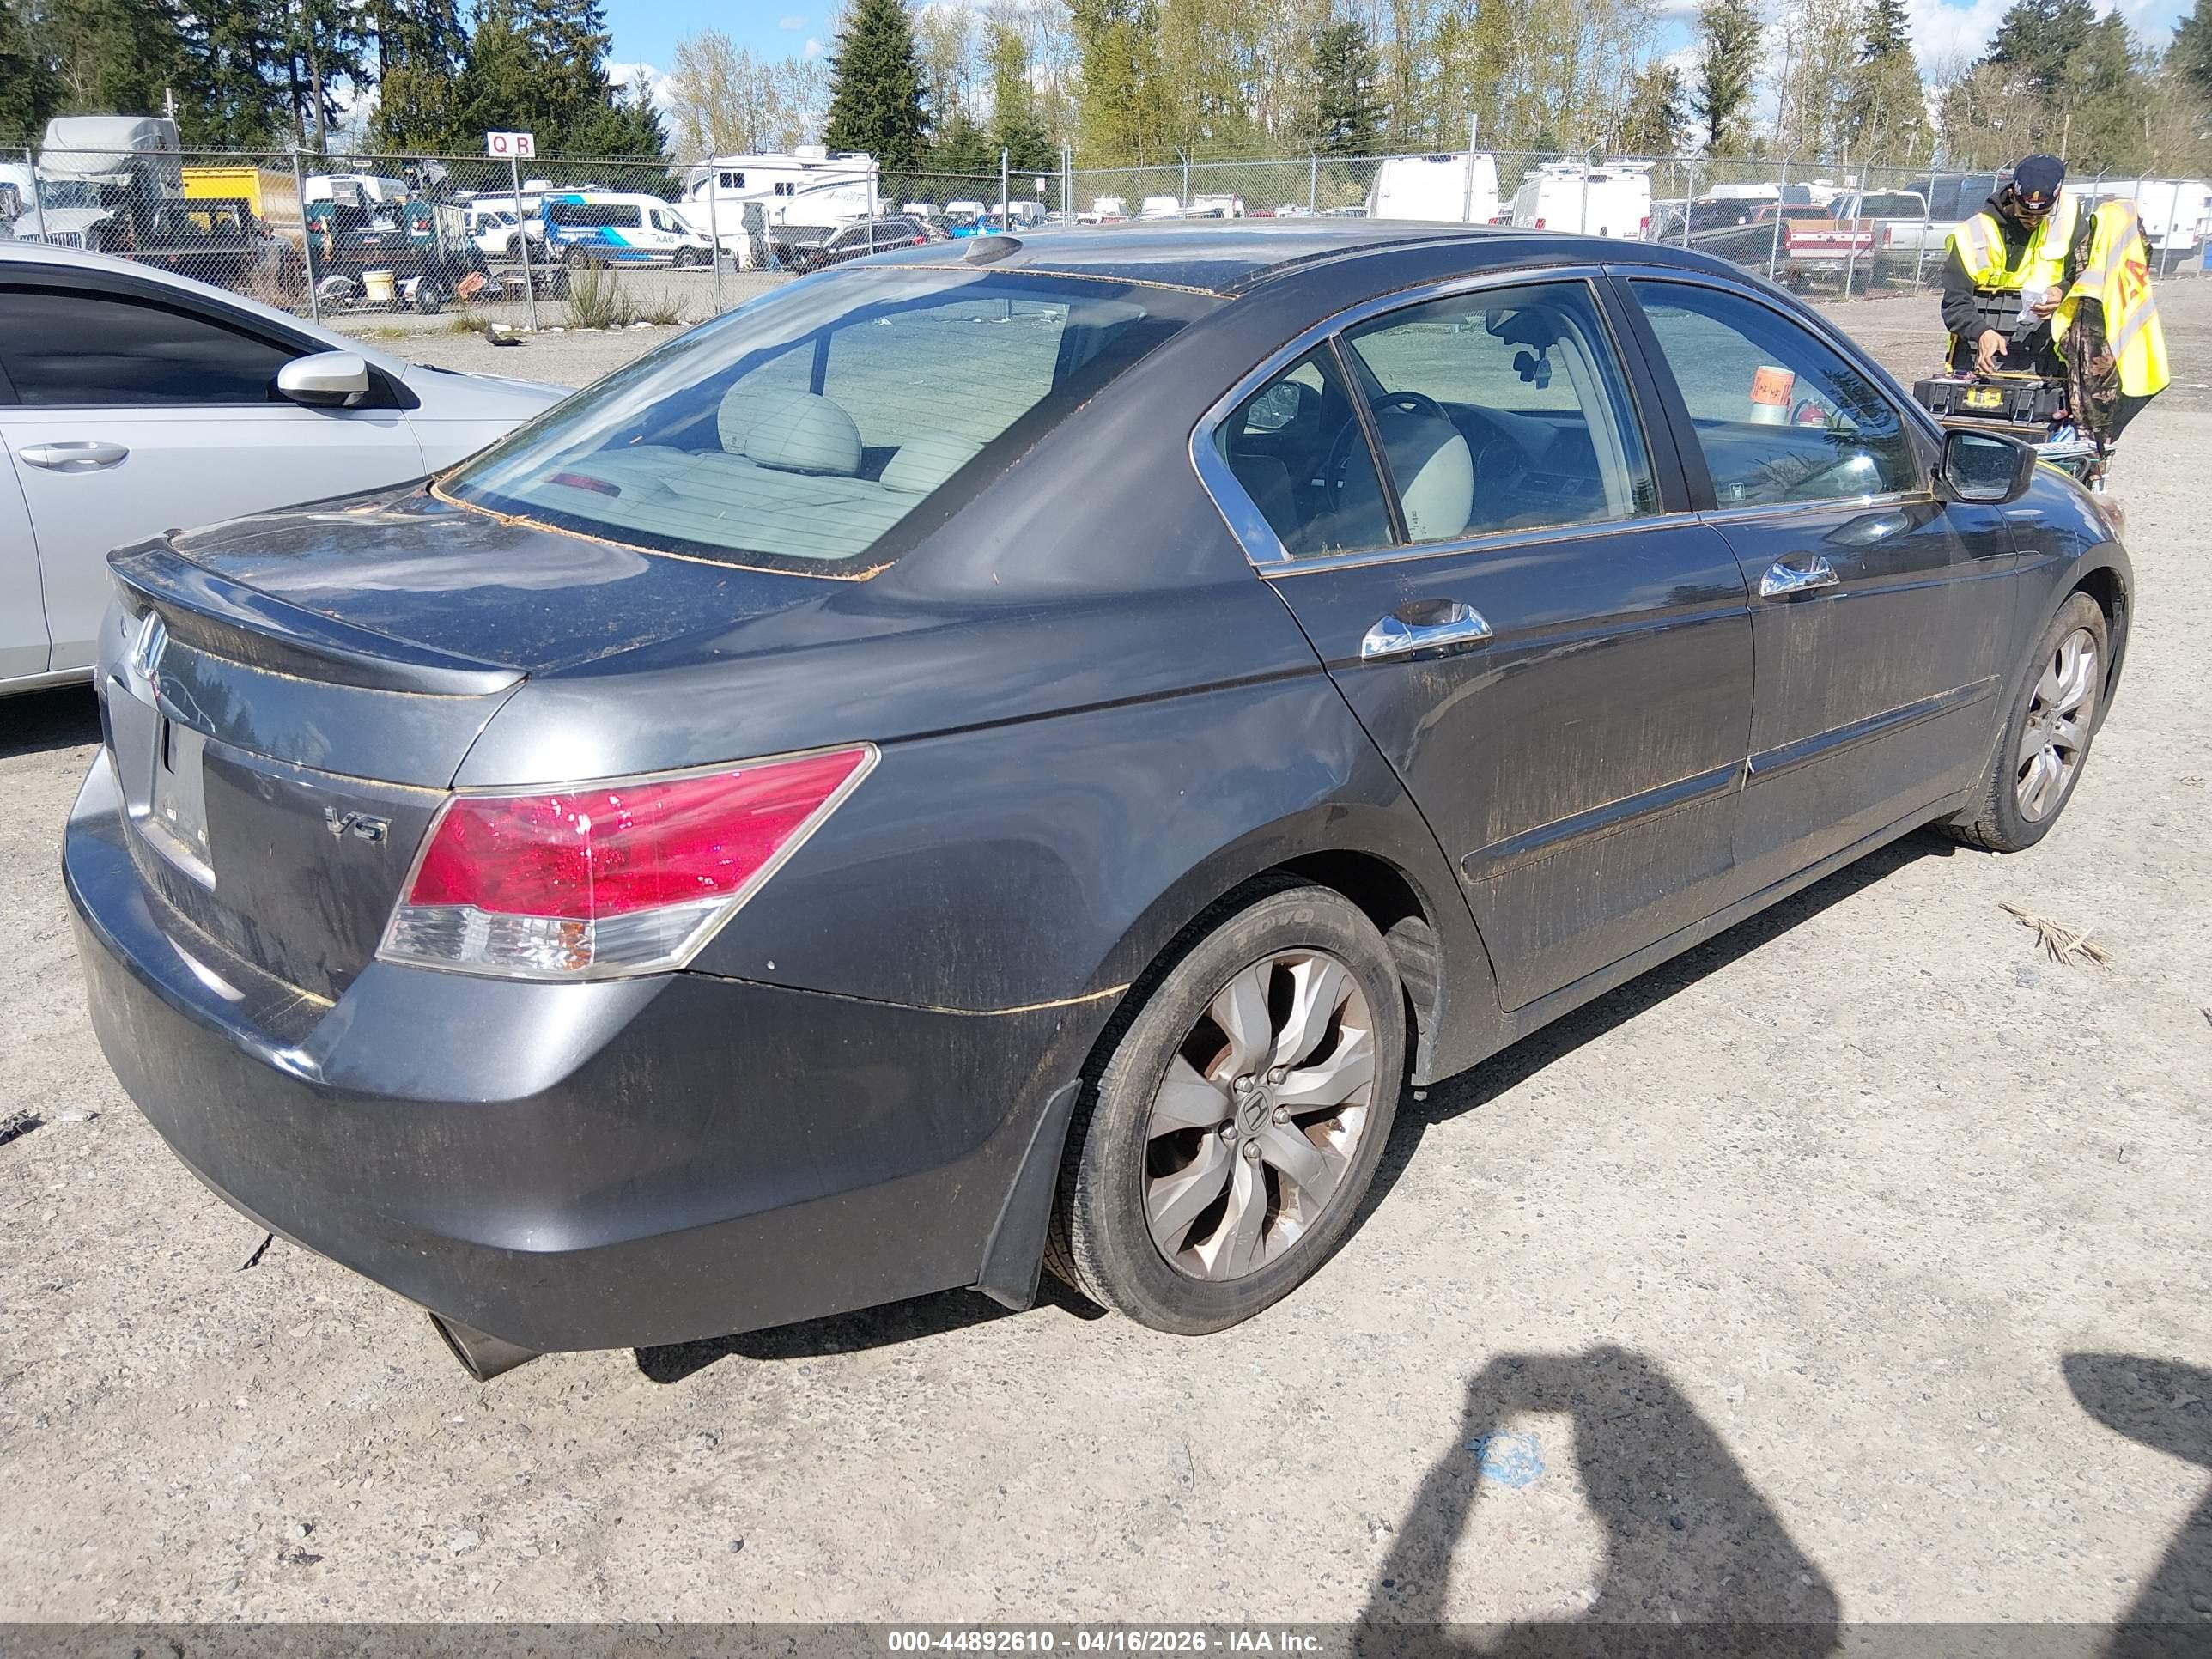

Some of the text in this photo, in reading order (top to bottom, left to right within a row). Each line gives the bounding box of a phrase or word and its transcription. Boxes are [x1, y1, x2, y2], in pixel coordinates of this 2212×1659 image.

[493, 136, 529, 153] Q R
[325, 806, 392, 842] V6
